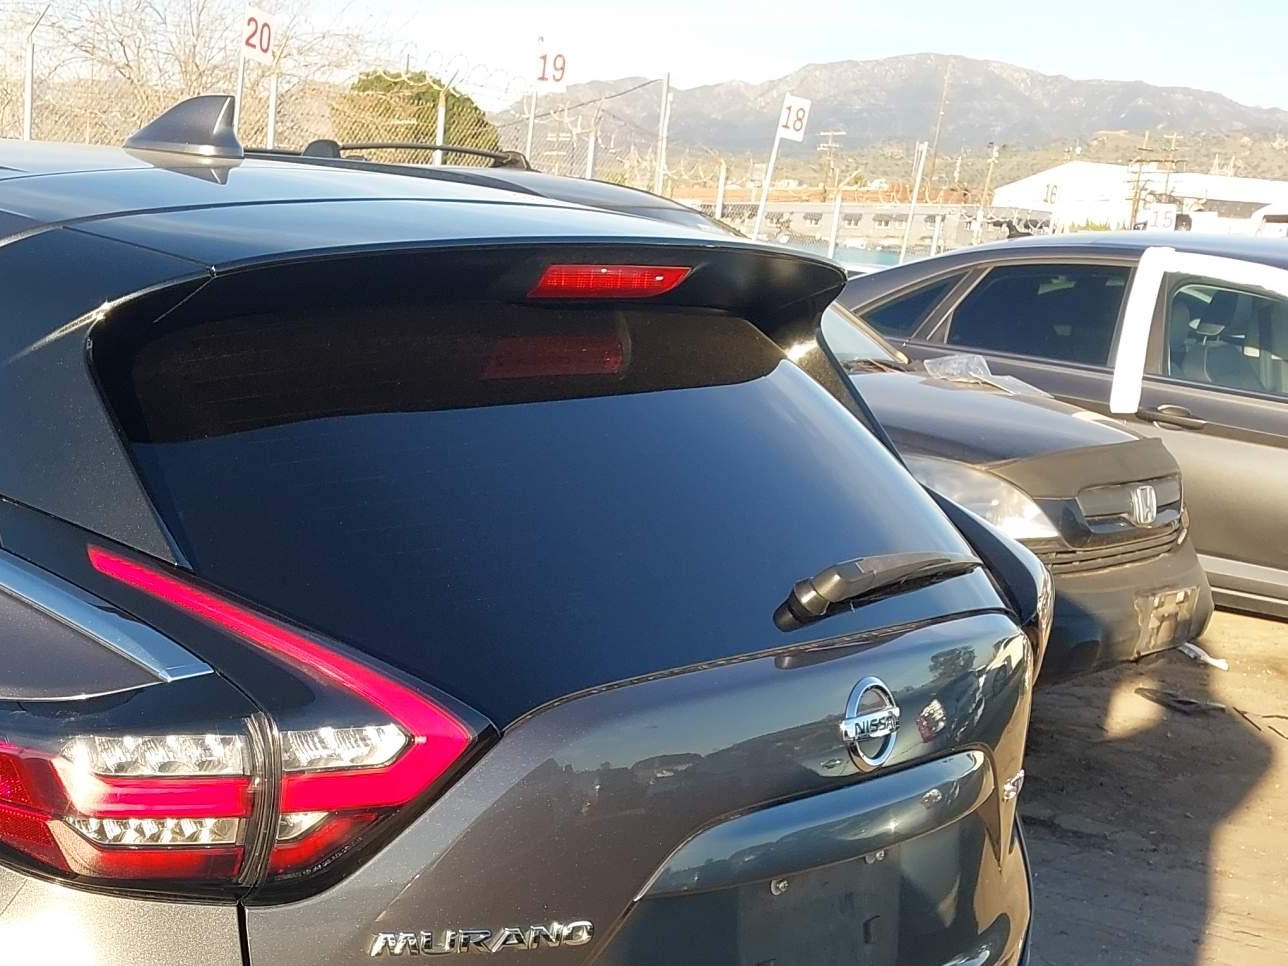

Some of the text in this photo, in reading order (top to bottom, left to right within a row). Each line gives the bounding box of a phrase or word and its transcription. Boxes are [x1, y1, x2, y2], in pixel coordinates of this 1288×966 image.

[245, 16, 271, 53] 20
[537, 54, 566, 82] 19
[781, 105, 806, 132] 18
[1149, 210, 1174, 229] 15
[368, 920, 594, 957] MURANO
